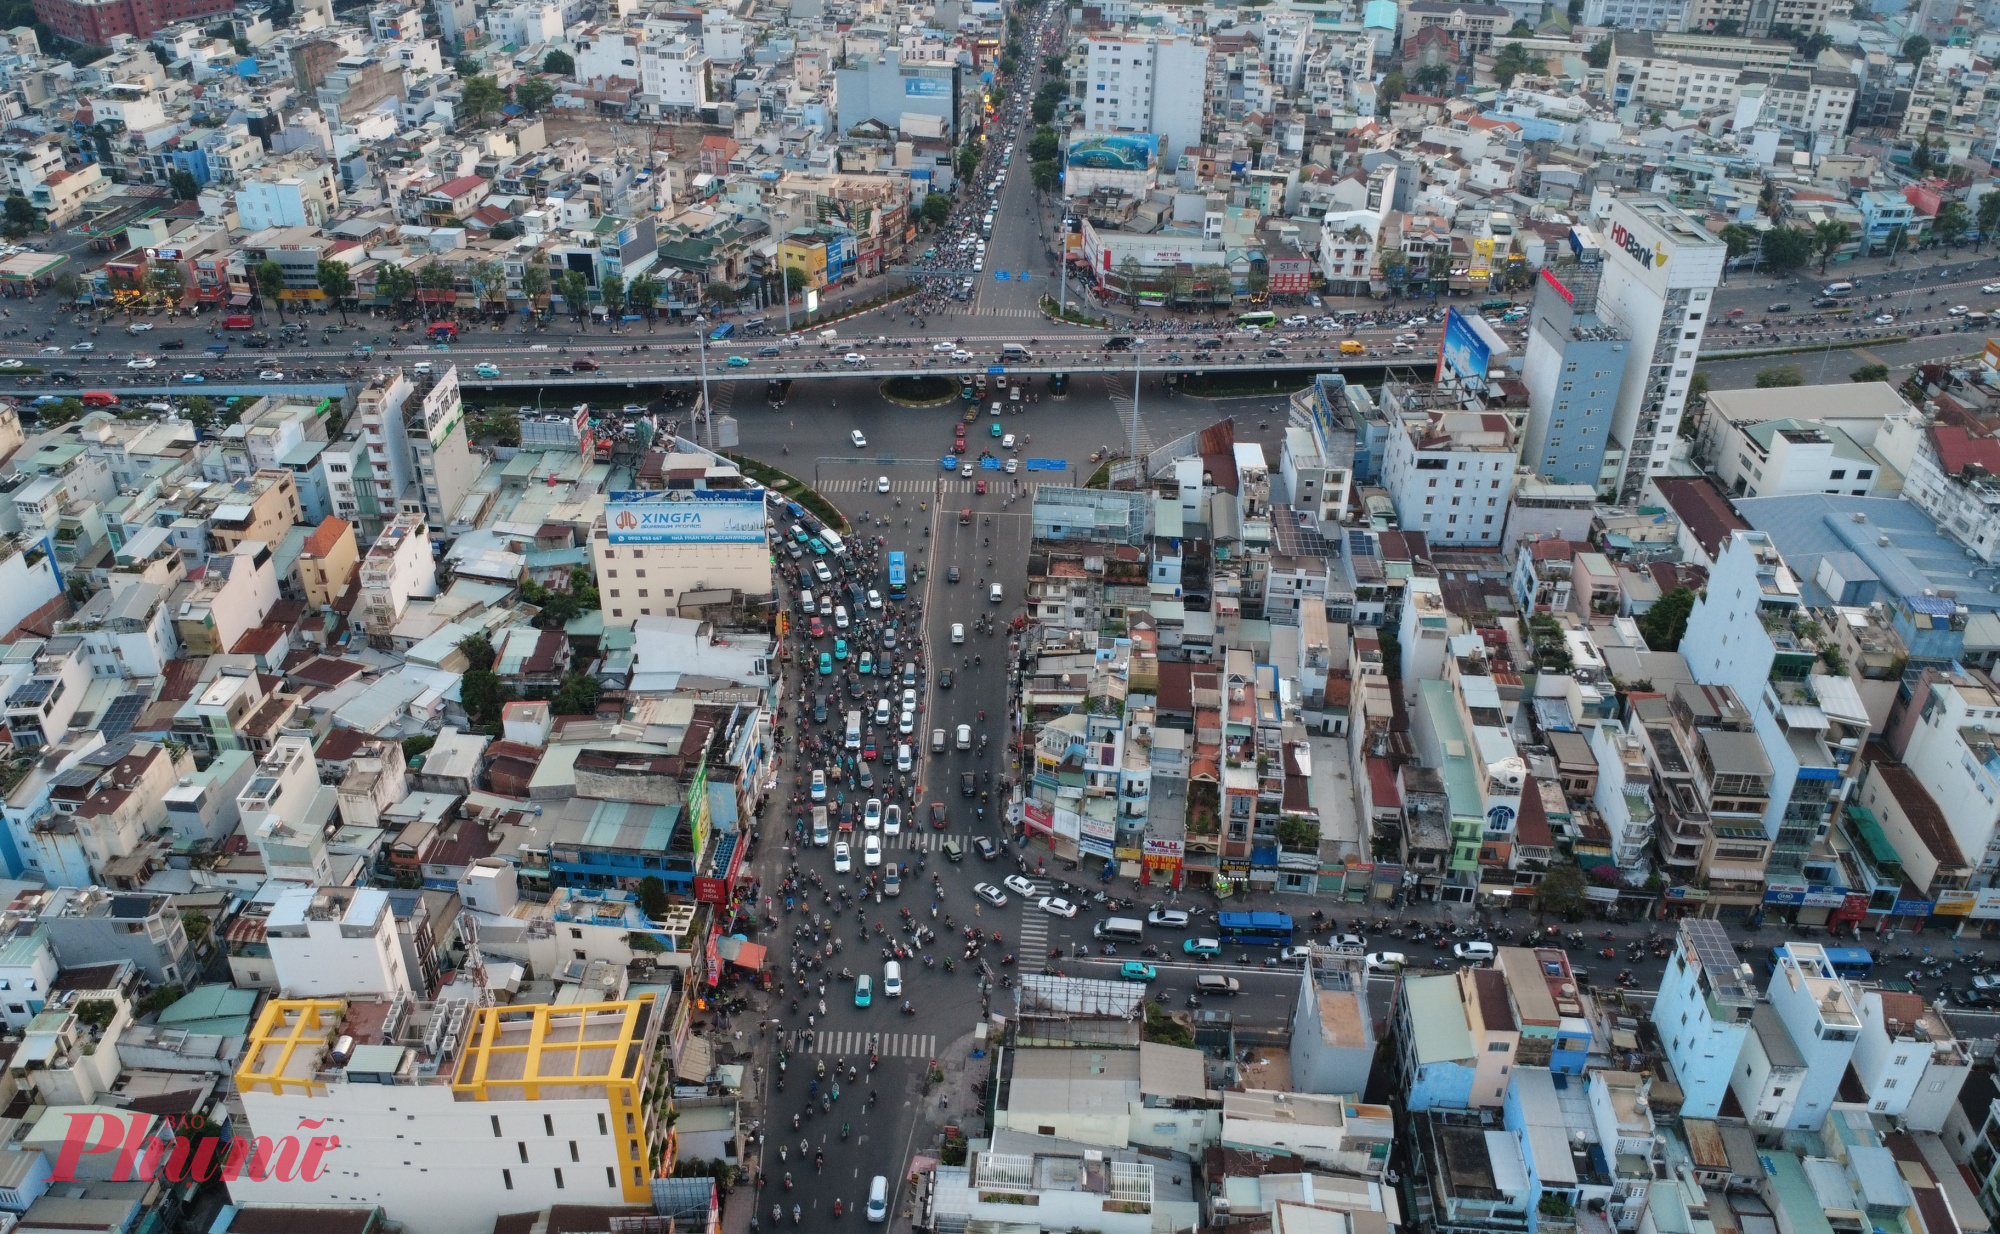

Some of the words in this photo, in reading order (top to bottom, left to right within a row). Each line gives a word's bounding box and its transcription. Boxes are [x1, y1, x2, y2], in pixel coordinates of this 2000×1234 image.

[1611, 221, 1653, 270] HDBank
[641, 513, 701, 523] XINGFA
[1150, 840, 1177, 849] MLH
